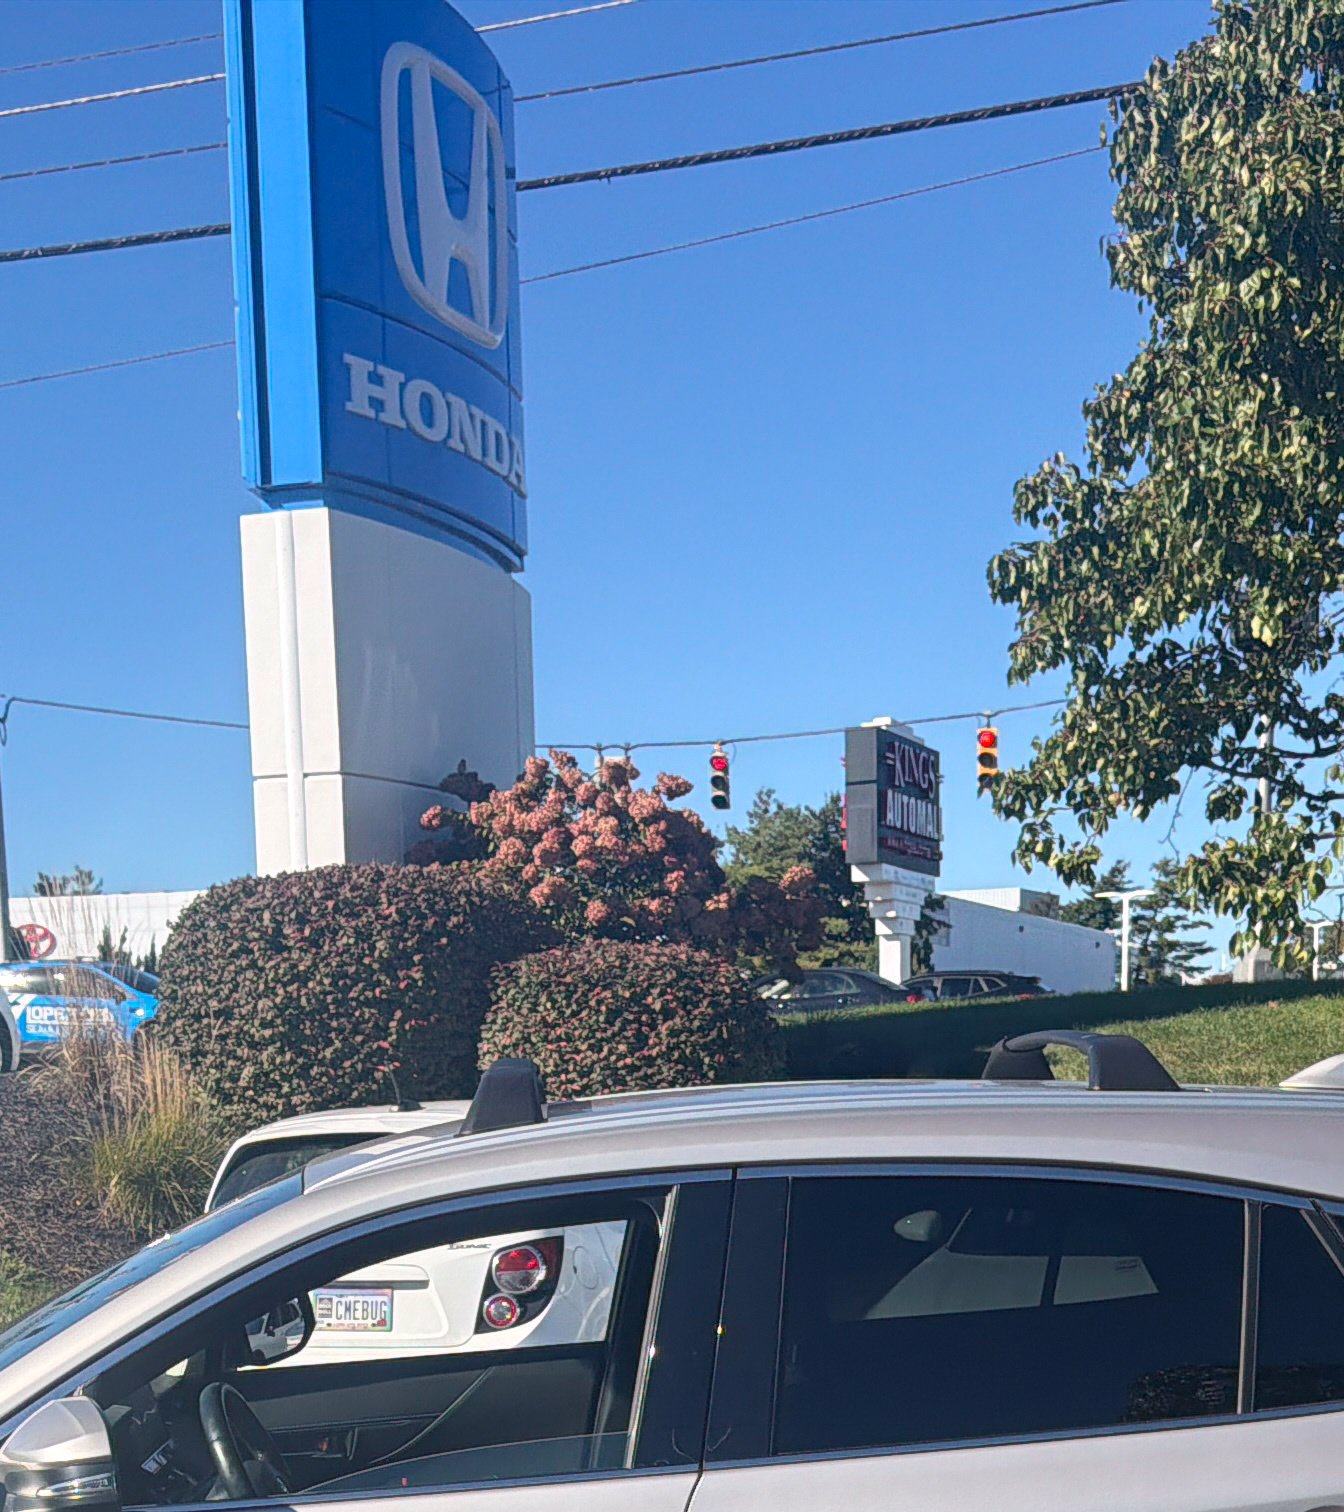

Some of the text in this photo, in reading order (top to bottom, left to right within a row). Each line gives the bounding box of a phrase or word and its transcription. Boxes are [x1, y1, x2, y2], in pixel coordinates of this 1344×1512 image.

[343, 353, 527, 499] HONDA
[894, 741, 936, 799] KINGS
[336, 1300, 387, 1321] CMEBUG
